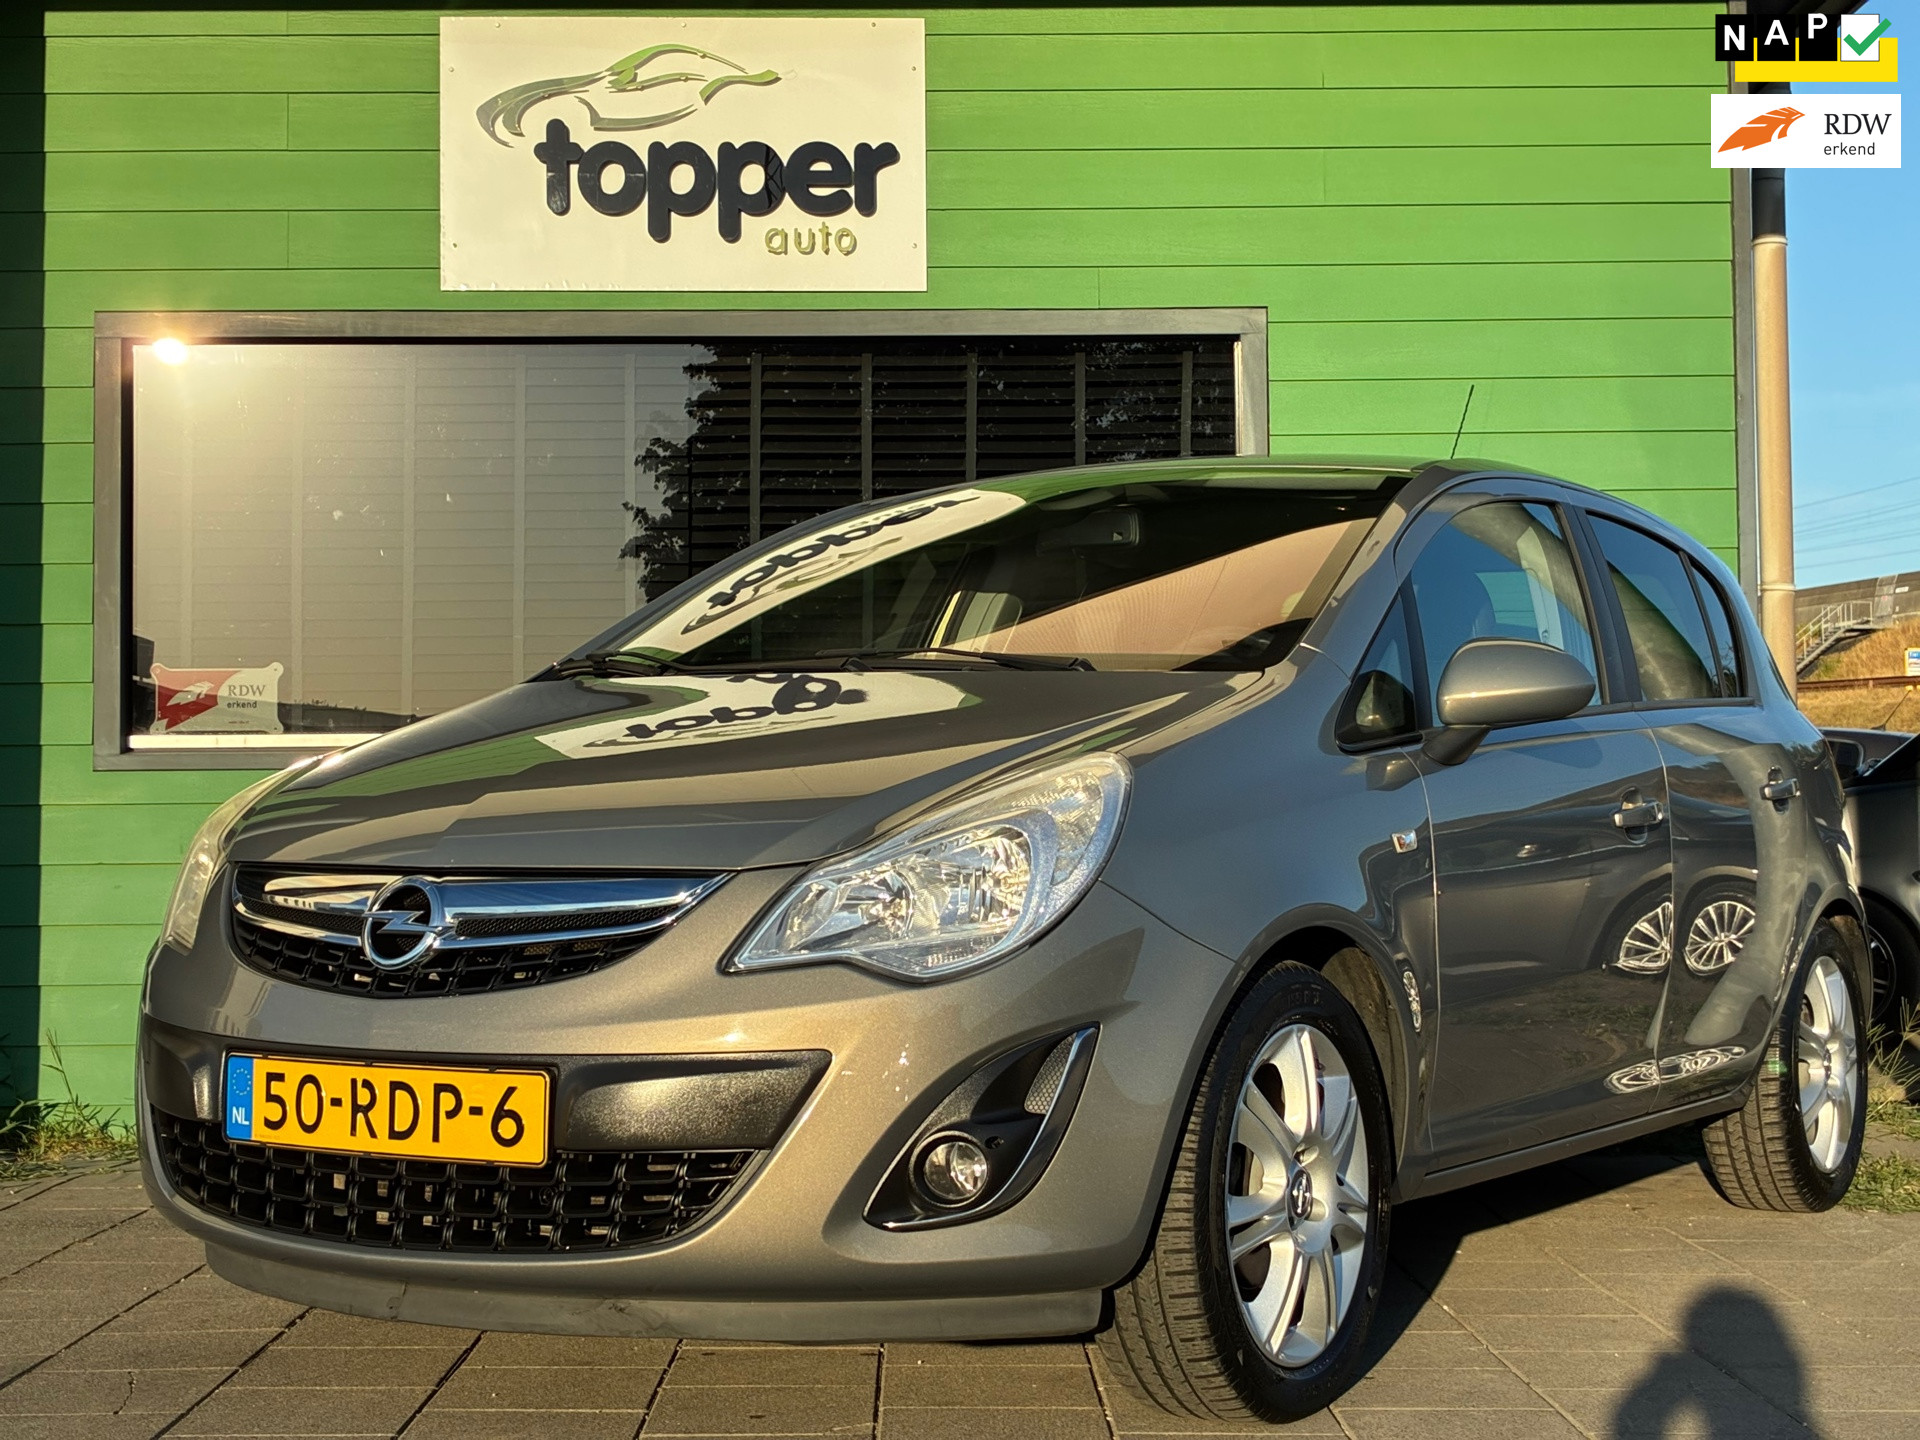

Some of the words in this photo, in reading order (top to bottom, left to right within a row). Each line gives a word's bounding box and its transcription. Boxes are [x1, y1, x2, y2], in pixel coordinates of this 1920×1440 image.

[533, 118, 901, 243] topper
[764, 221, 857, 255] auto
[226, 700, 258, 709] erkend
[228, 684, 266, 697] RDW
[231, 1106, 250, 1126] NL
[263, 1072, 525, 1148] 50-RDP-6
